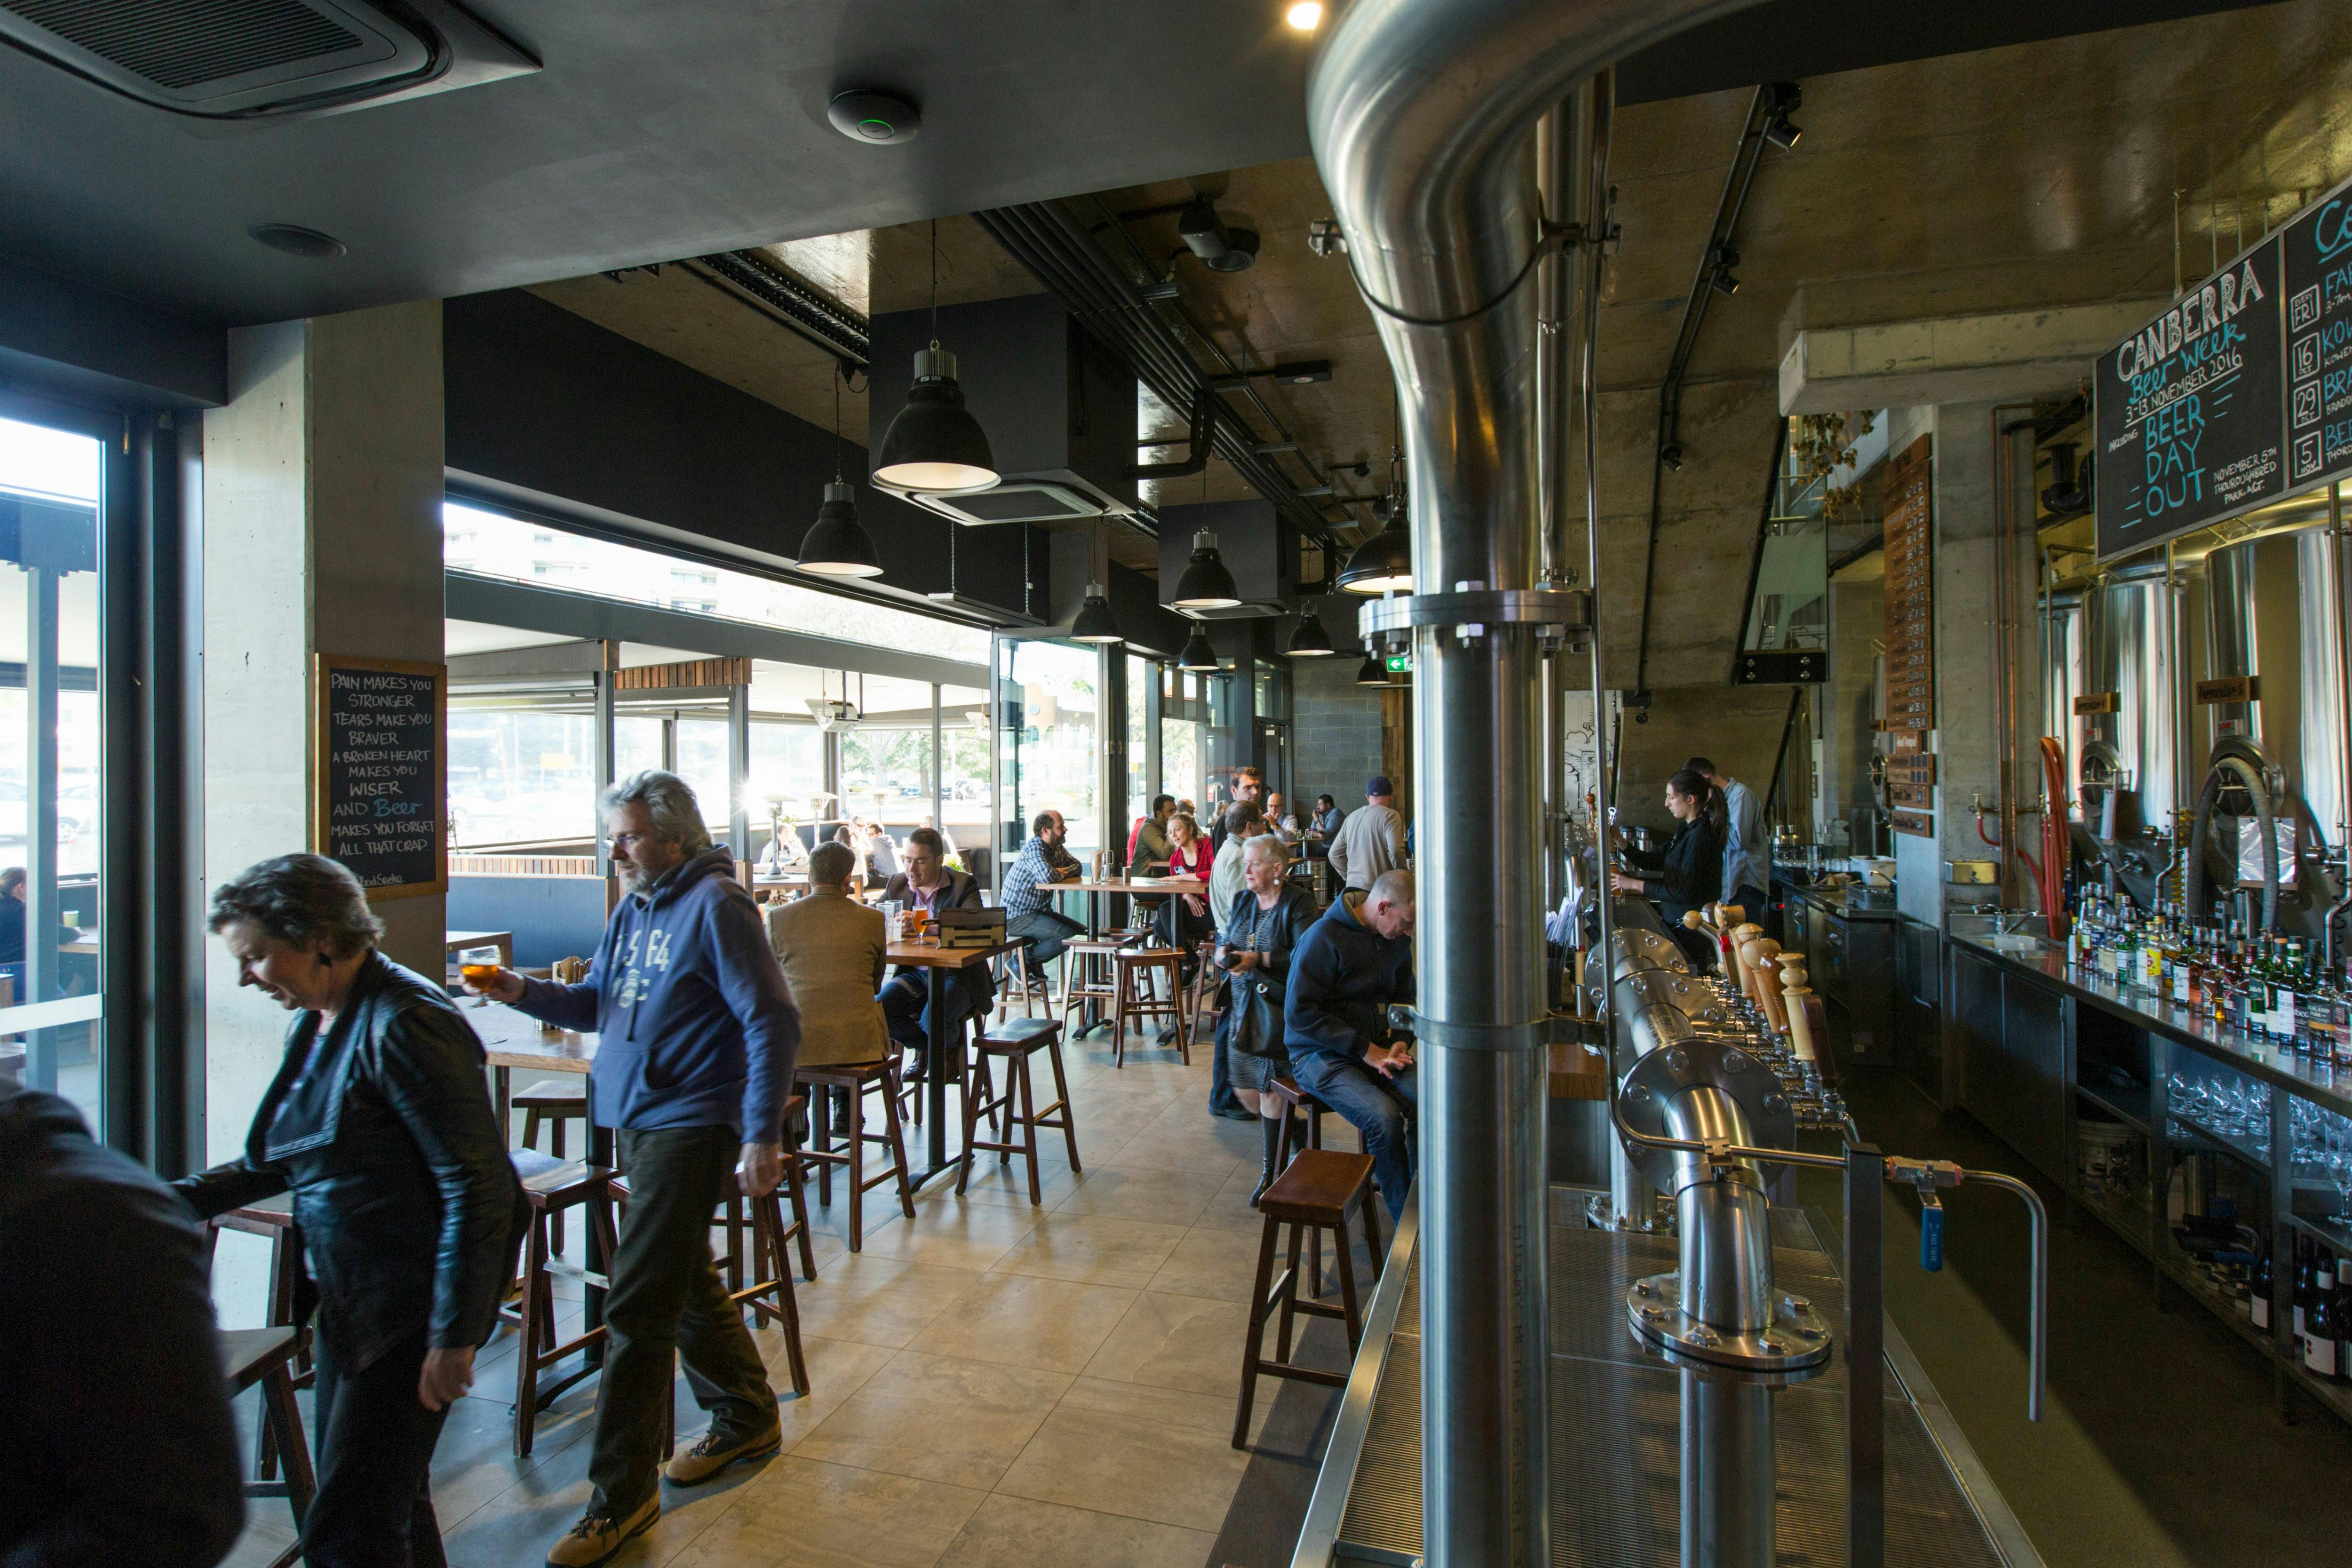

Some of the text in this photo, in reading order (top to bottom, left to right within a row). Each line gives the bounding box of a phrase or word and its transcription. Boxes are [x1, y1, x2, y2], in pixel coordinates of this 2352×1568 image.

[2117, 259, 2265, 382] CANBERRA
[2295, 297, 2313, 326] FRI
[2298, 340, 2313, 369] 16
[2298, 364, 2312, 375] OCT
[2125, 346, 2242, 423] 3-13 NOVEMBER 2016
[2128, 358, 2177, 405] Beer
[2297, 387, 2316, 418] 29
[2146, 394, 2205, 451] BEER
[2300, 413, 2314, 423] OCT
[2109, 429, 2139, 453] INCLUDING
[2146, 429, 2202, 484] DAY
[2301, 440, 2313, 465] 5
[2213, 446, 2277, 482] NOVEMBER 5TH
[2301, 460, 2316, 475] NOV
[2146, 468, 2206, 517] OUT
[331, 673, 431, 691] PAIN MAKES YOU
[349, 693, 415, 708] STRONGER
[333, 712, 432, 727] TEARS MAKE YOU
[349, 731, 399, 746] BRAVER
[333, 750, 431, 763] A BROKEN HEART
[349, 765, 417, 777] MAKES YOU
[350, 781, 403, 796] WISER
[333, 798, 422, 817] AND Beer
[331, 820, 435, 837] MAKES YOU FORGET
[339, 842, 363, 856] ALL
[366, 840, 396, 854] THAT
